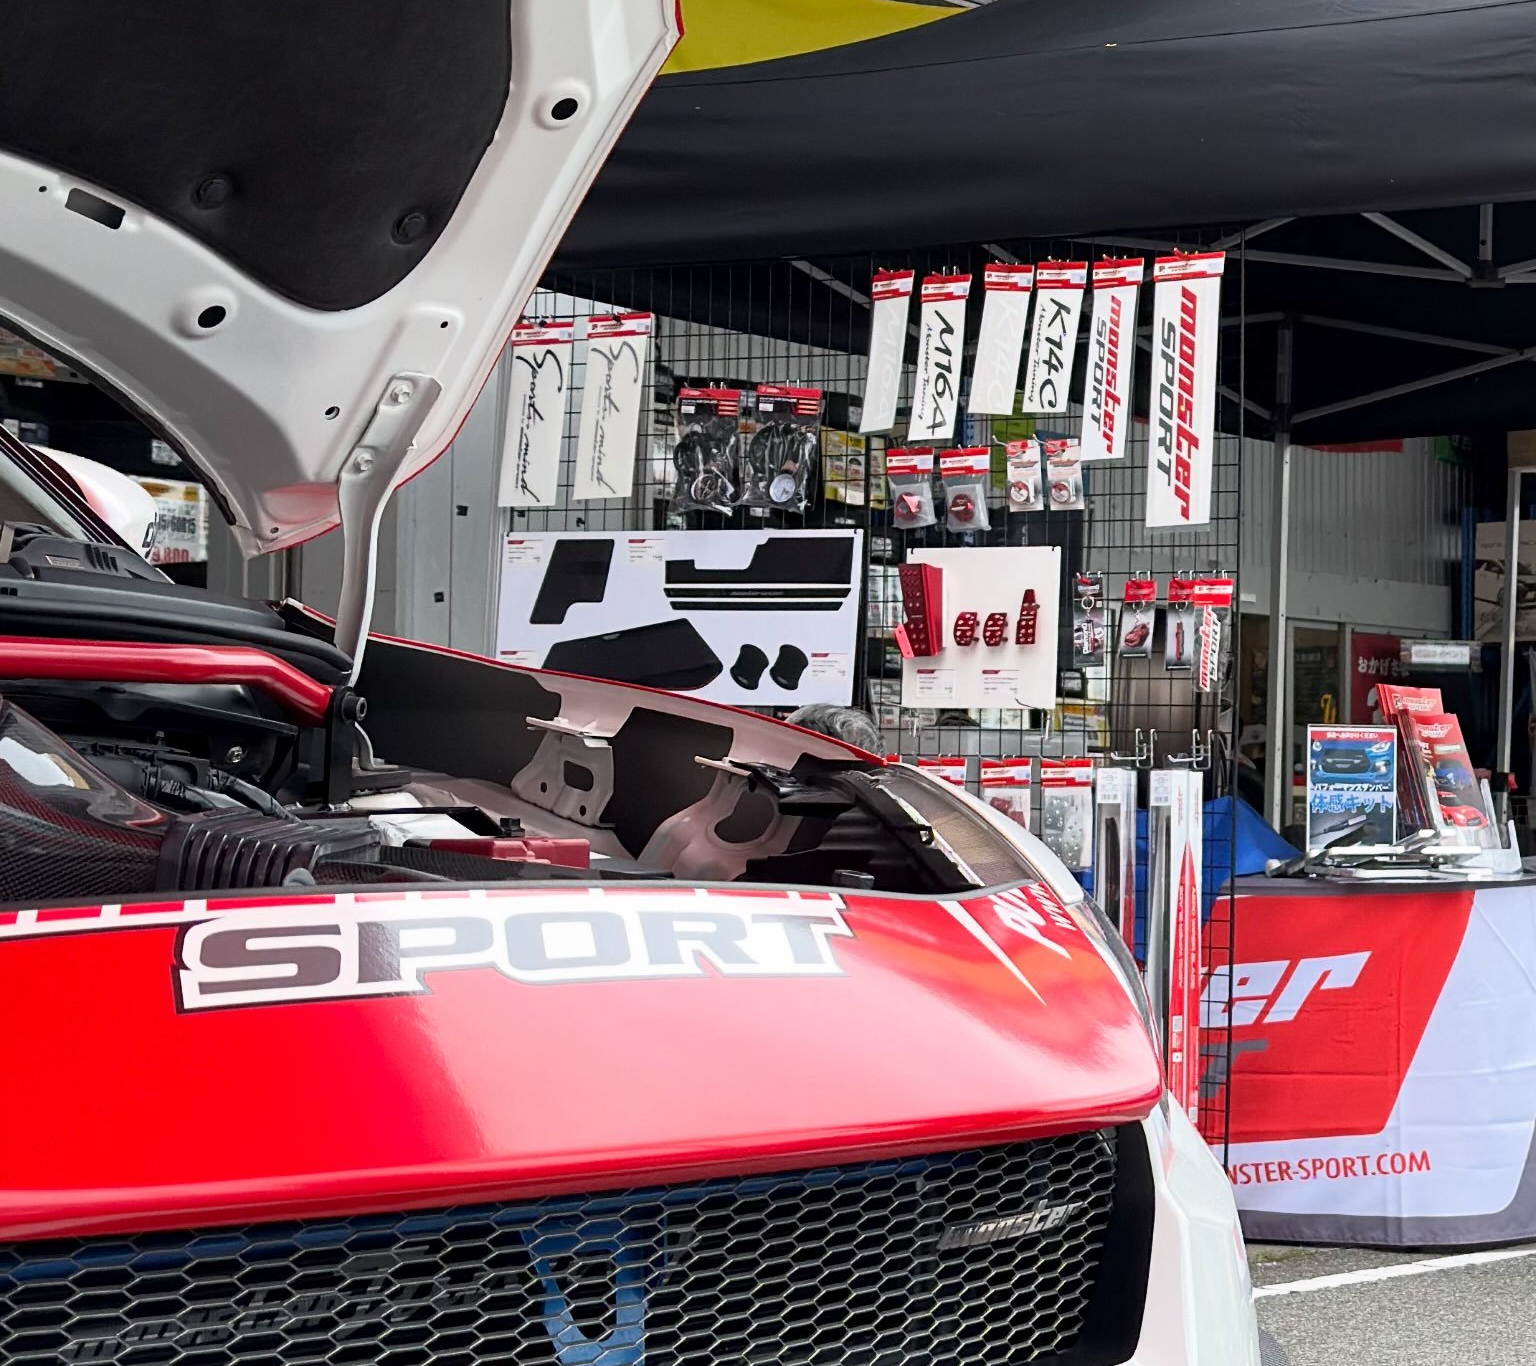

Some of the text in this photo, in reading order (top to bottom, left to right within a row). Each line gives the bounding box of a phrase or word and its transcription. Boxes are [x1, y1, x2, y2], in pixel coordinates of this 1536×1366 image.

[925, 309, 955, 437] M16A
[1040, 297, 1072, 410] K14C
[1090, 316, 1107, 432] SPORT
[1100, 295, 1121, 455] monster
[1156, 317, 1176, 487] SPORT
[1174, 285, 1200, 522] monster
[1311, 793, 1393, 814] 体感キット
[198, 910, 840, 995] SPORT
[936, 1198, 1086, 1250] monster
[1229, 1150, 1432, 1185] NSTER-SPORT.COM
